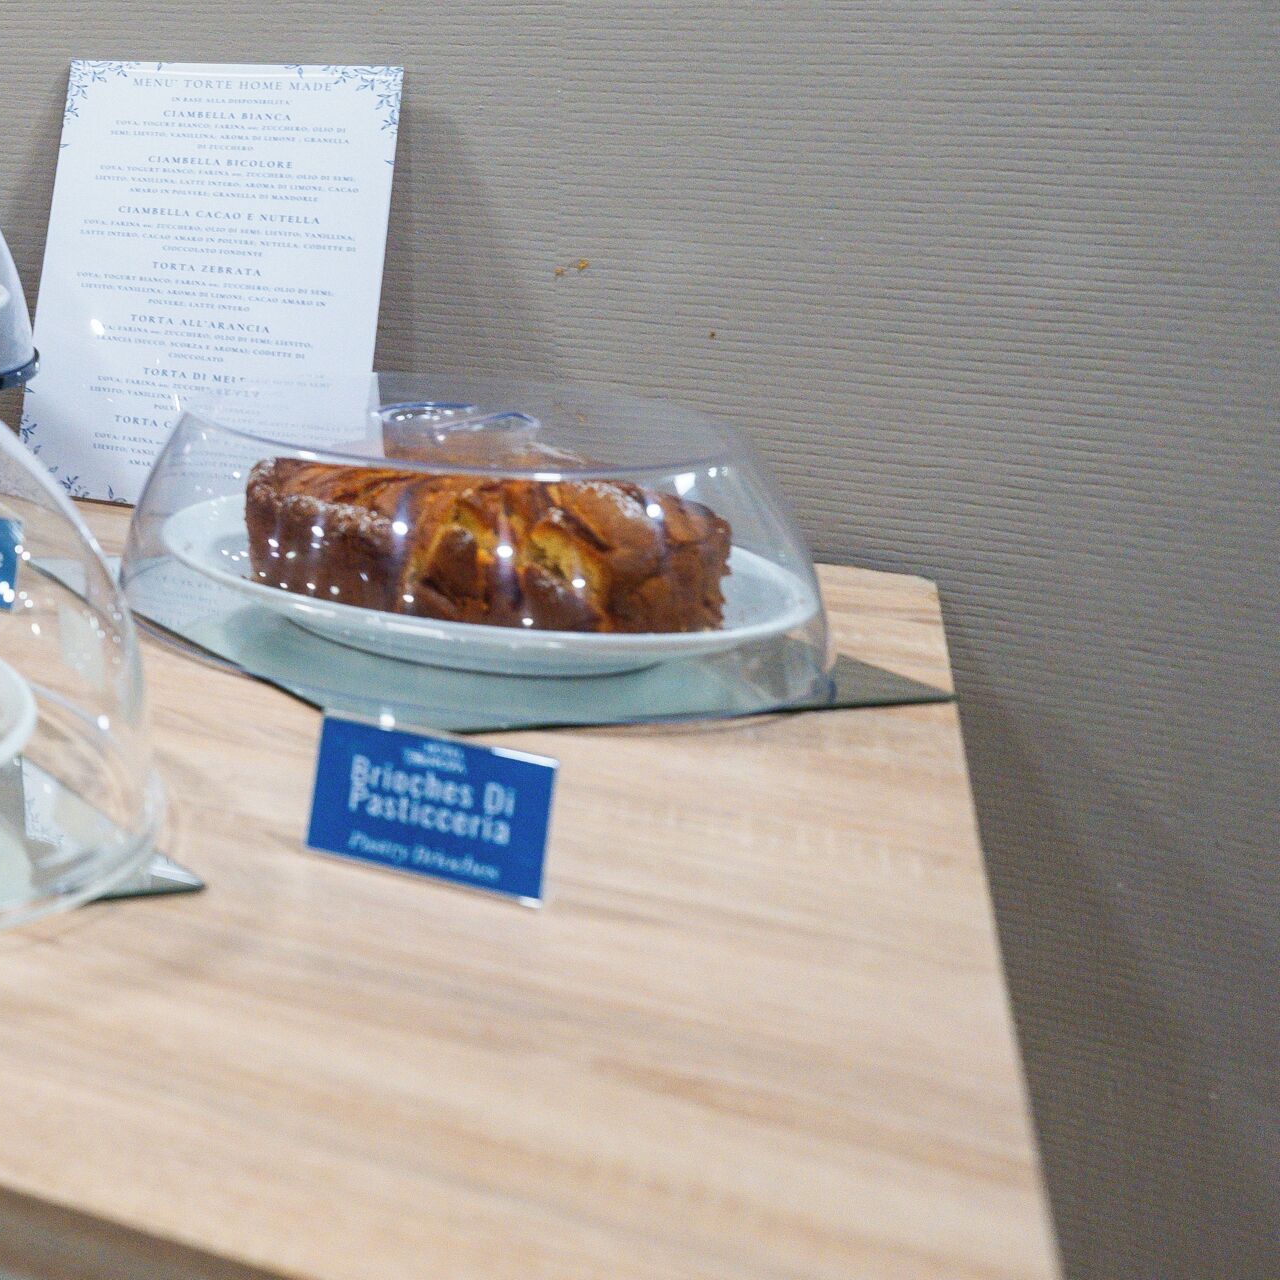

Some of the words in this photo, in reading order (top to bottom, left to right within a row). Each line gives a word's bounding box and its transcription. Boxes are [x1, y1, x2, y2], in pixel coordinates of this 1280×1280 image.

[183, 79, 232, 90] TORTE
[239, 80, 282, 91] HOME
[288, 81, 332, 92] MADE
[162, 110, 236, 120] CIAMBELLA
[241, 112, 291, 121] BIANCA
[147, 155, 221, 166] CIAMBELLA
[226, 159, 294, 169] BICOLORE
[117, 205, 191, 218] CIAMBELLA
[195, 210, 241, 220] CACAO
[247, 212, 255, 221] E
[259, 213, 320, 225] NUTELLA
[152, 260, 196, 272] TORTA
[200, 264, 262, 277] ZEBRATA
[130, 313, 174, 325] TORTA
[143, 367, 187, 379] TORTA
[191, 371, 207, 381] DI
[115, 414, 159, 428] TORTA
[350, 753, 474, 810] Brioches
[483, 781, 517, 819] Di
[348, 780, 512, 846] Pasticceria
